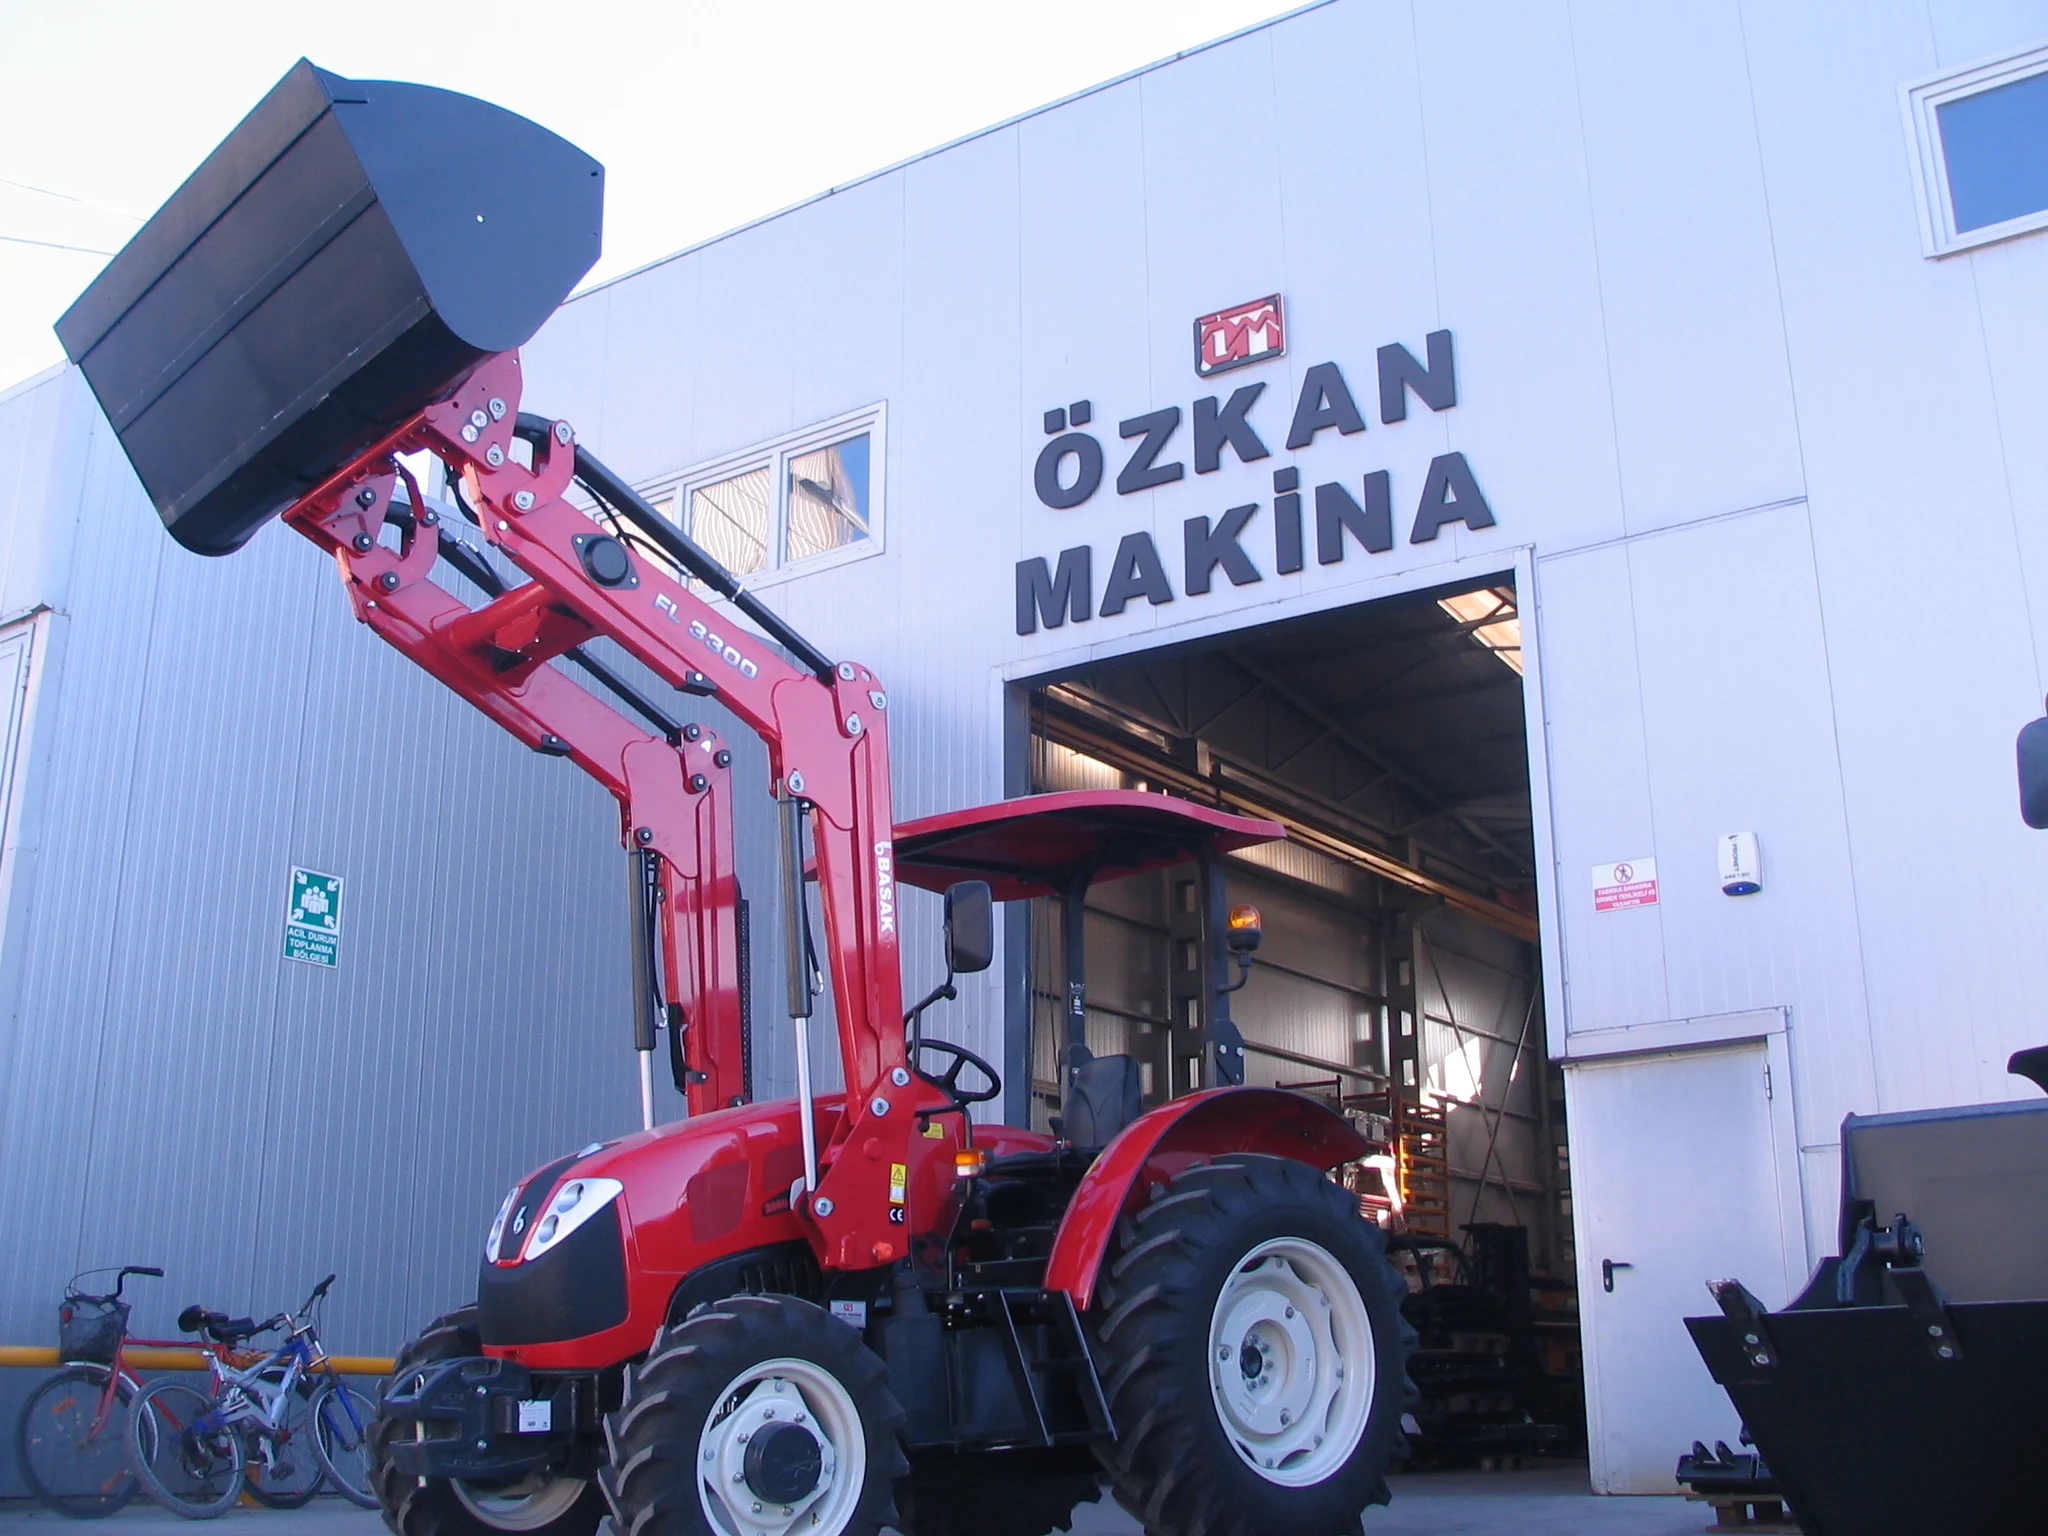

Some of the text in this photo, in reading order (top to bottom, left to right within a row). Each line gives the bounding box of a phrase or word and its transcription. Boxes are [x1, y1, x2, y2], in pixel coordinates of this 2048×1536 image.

[1034, 328, 1457, 509] ÖZKAN
[1015, 451, 1497, 636] MAKİNA
[653, 592, 759, 680] FL 3300
[877, 857, 894, 933] BASAK
[290, 938, 333, 955] TOPLANMA
[293, 949, 329, 964] BÖLGESİ
[308, 931, 336, 945] DURUM
[889, 1207, 904, 1222] CE
